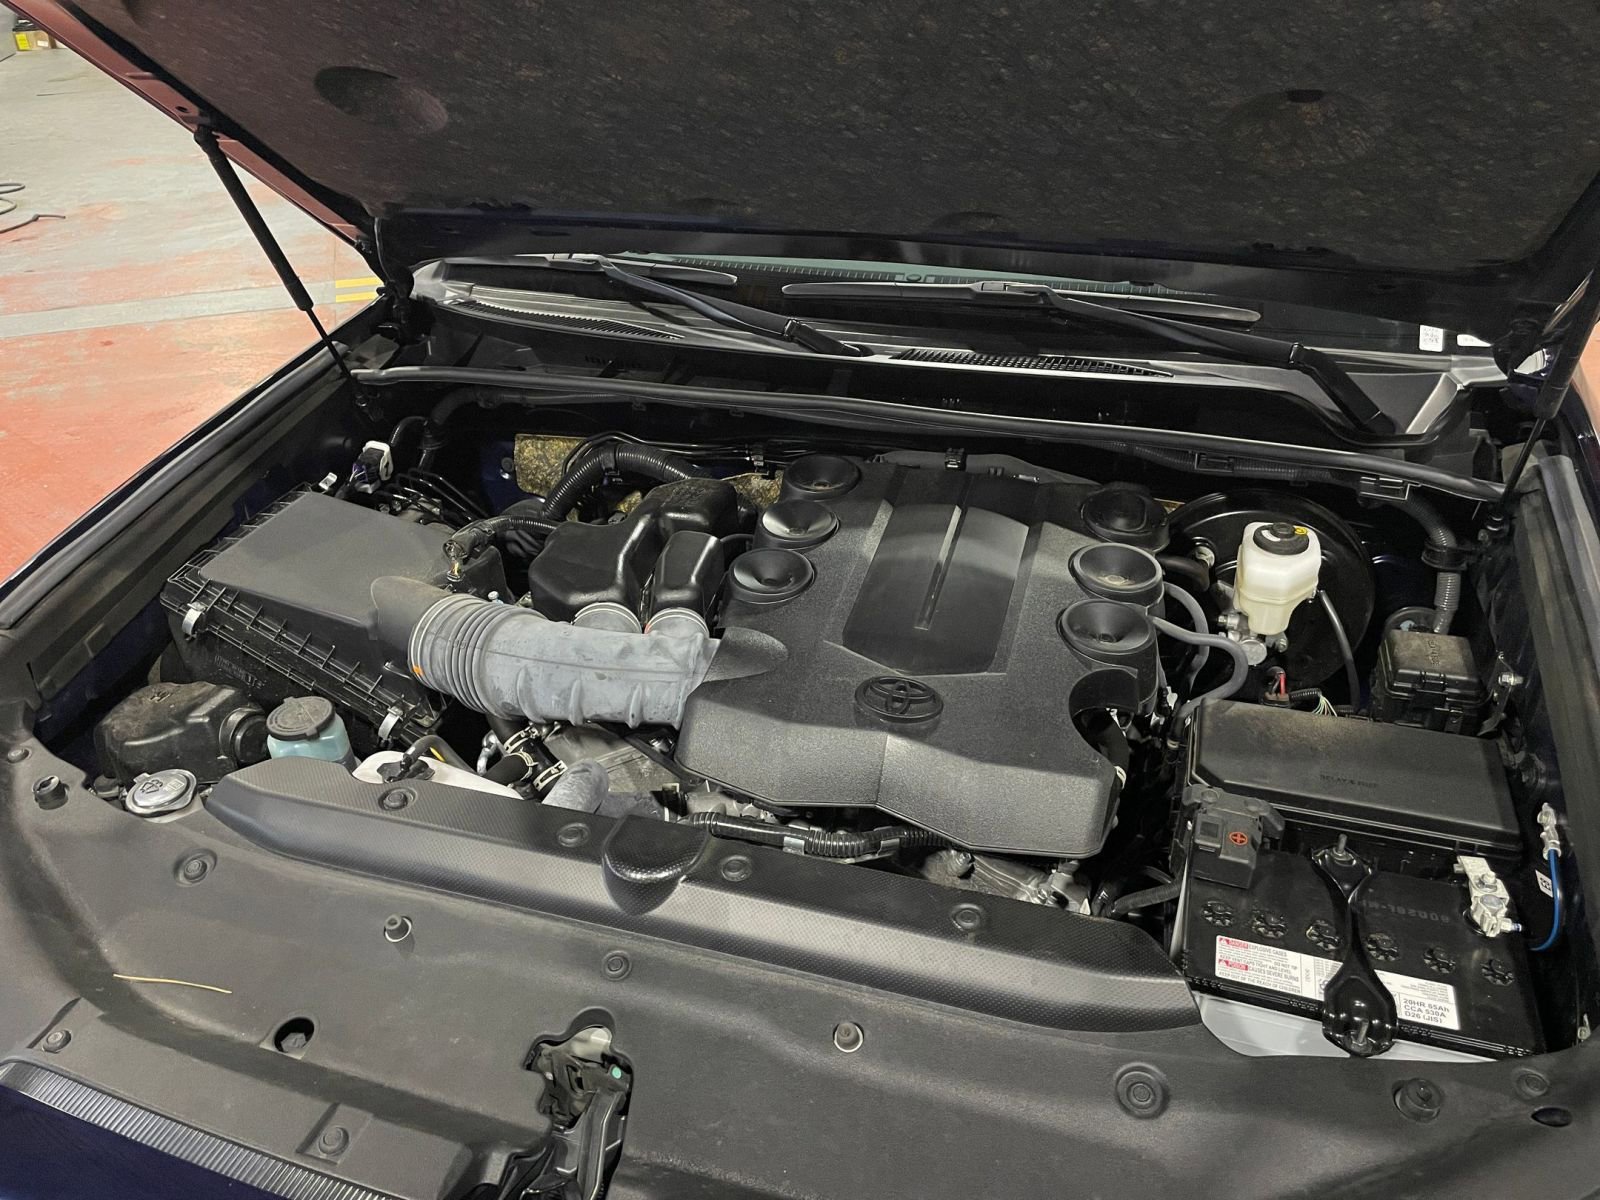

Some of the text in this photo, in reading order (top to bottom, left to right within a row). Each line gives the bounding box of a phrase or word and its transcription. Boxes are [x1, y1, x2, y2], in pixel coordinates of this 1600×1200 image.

[1249, 965, 1265, 975] CAUSES
[1266, 970, 1283, 979] SEVERE
[1284, 974, 1299, 982] BURNS
[1256, 979, 1271, 987] REACH
[1403, 997, 1427, 1008] 20HR
[1404, 1004, 1423, 1014] CCA
[1405, 1011, 1443, 1024] D26 (JIS)
